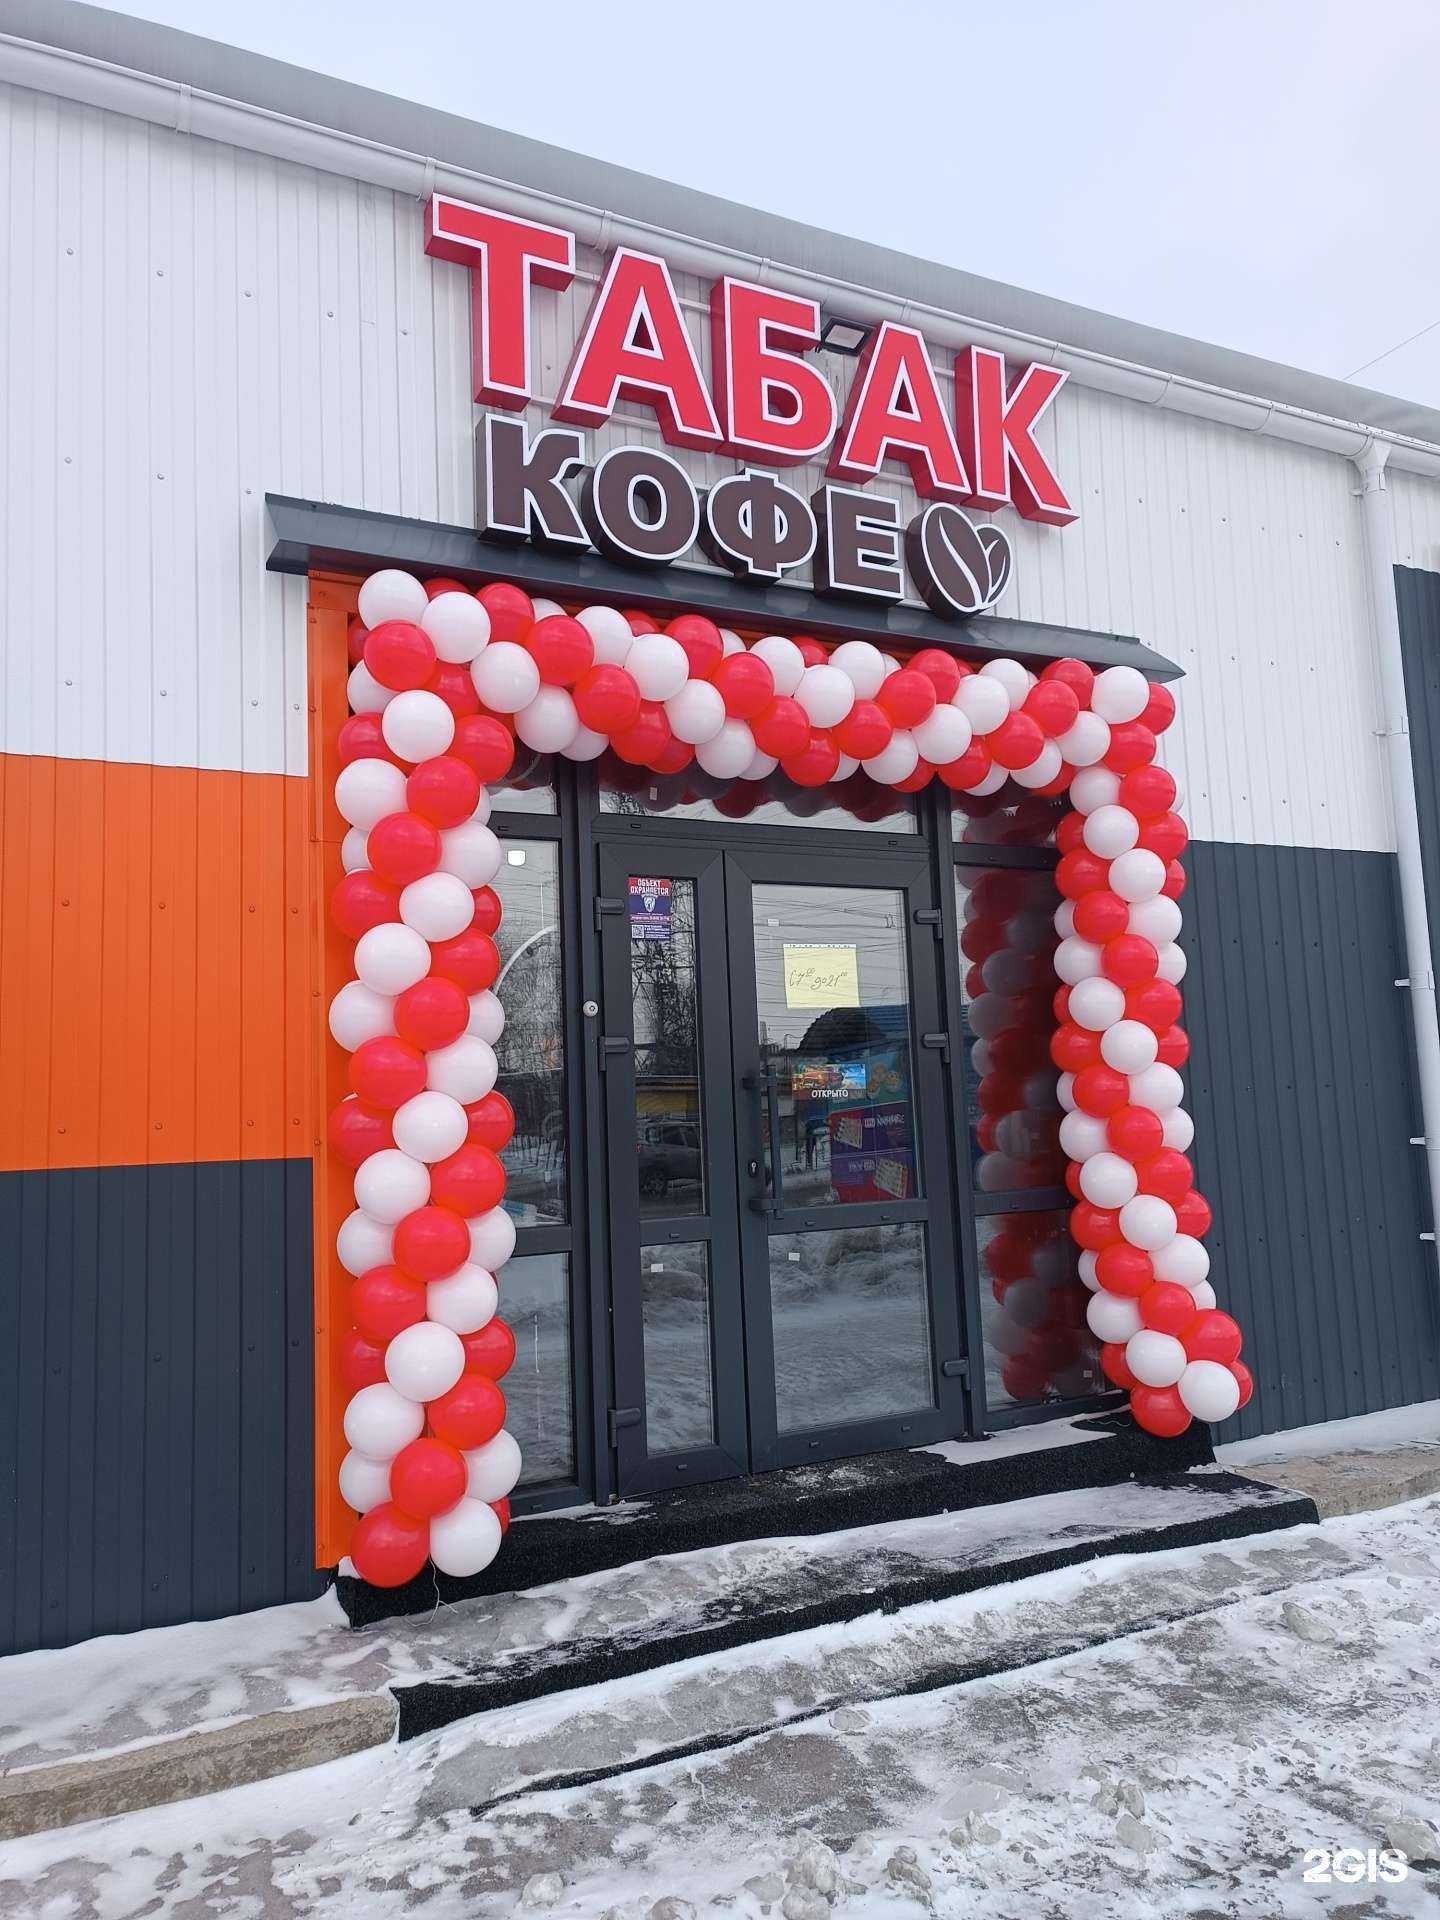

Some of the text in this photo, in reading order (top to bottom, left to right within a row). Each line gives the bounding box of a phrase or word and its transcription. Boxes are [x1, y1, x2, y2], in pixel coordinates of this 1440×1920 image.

[425, 192, 1080, 527] ТАБАК
[477, 412, 905, 606] КОФЕ
[637, 878, 661, 887] ОБЪЕКТ
[811, 1089, 849, 1099] ОТКРЫТО
